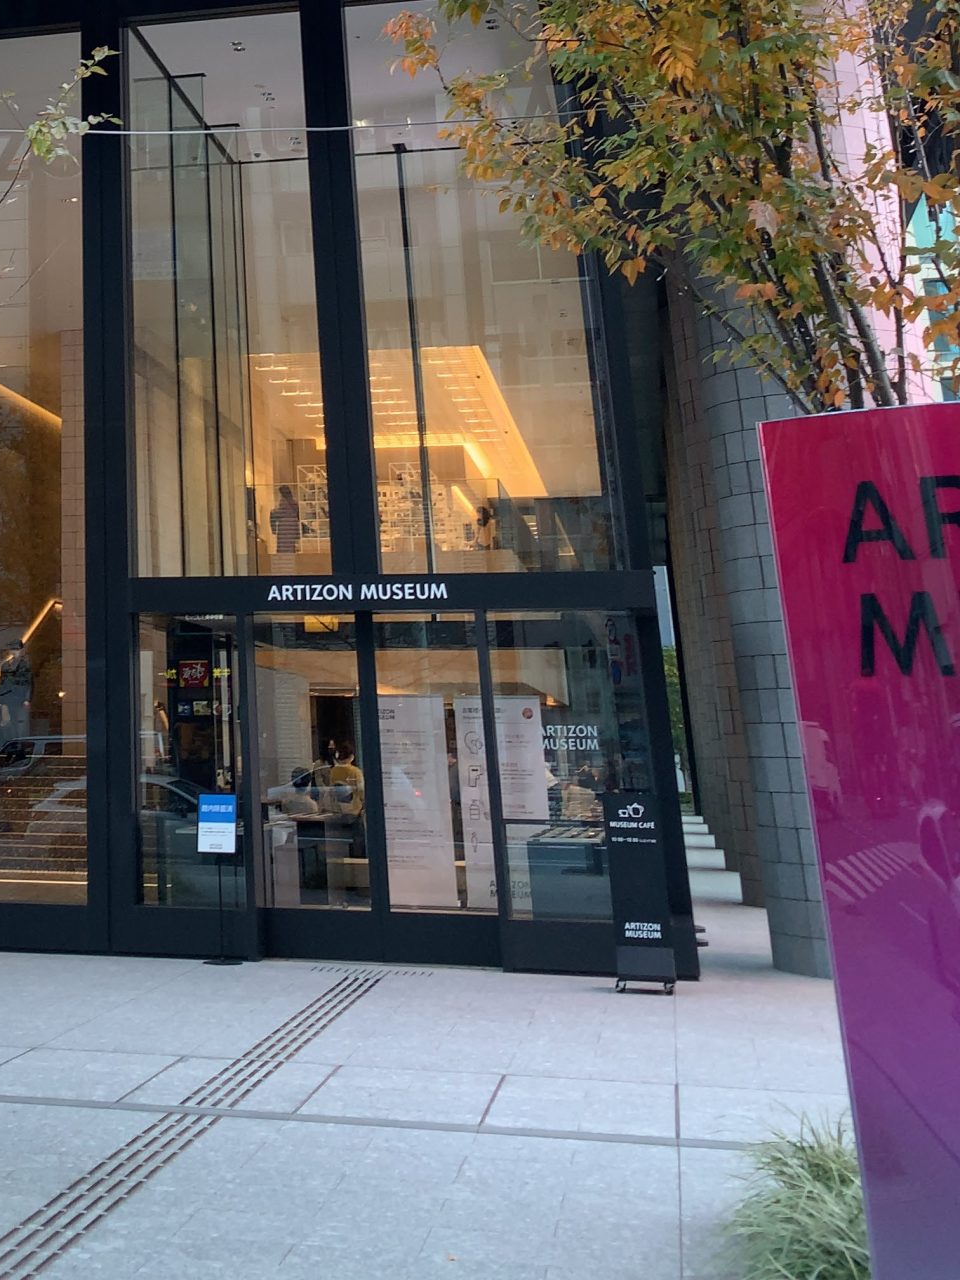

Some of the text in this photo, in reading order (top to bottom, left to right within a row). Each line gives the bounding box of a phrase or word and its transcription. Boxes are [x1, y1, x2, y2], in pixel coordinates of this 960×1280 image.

[267, 582, 449, 601] ARTIZON MUSEUM
[860, 591, 955, 677] M
[542, 738, 599, 751] MUSEUM
[624, 921, 661, 931] ARTIZON
[624, 930, 662, 939] MUSEUM
